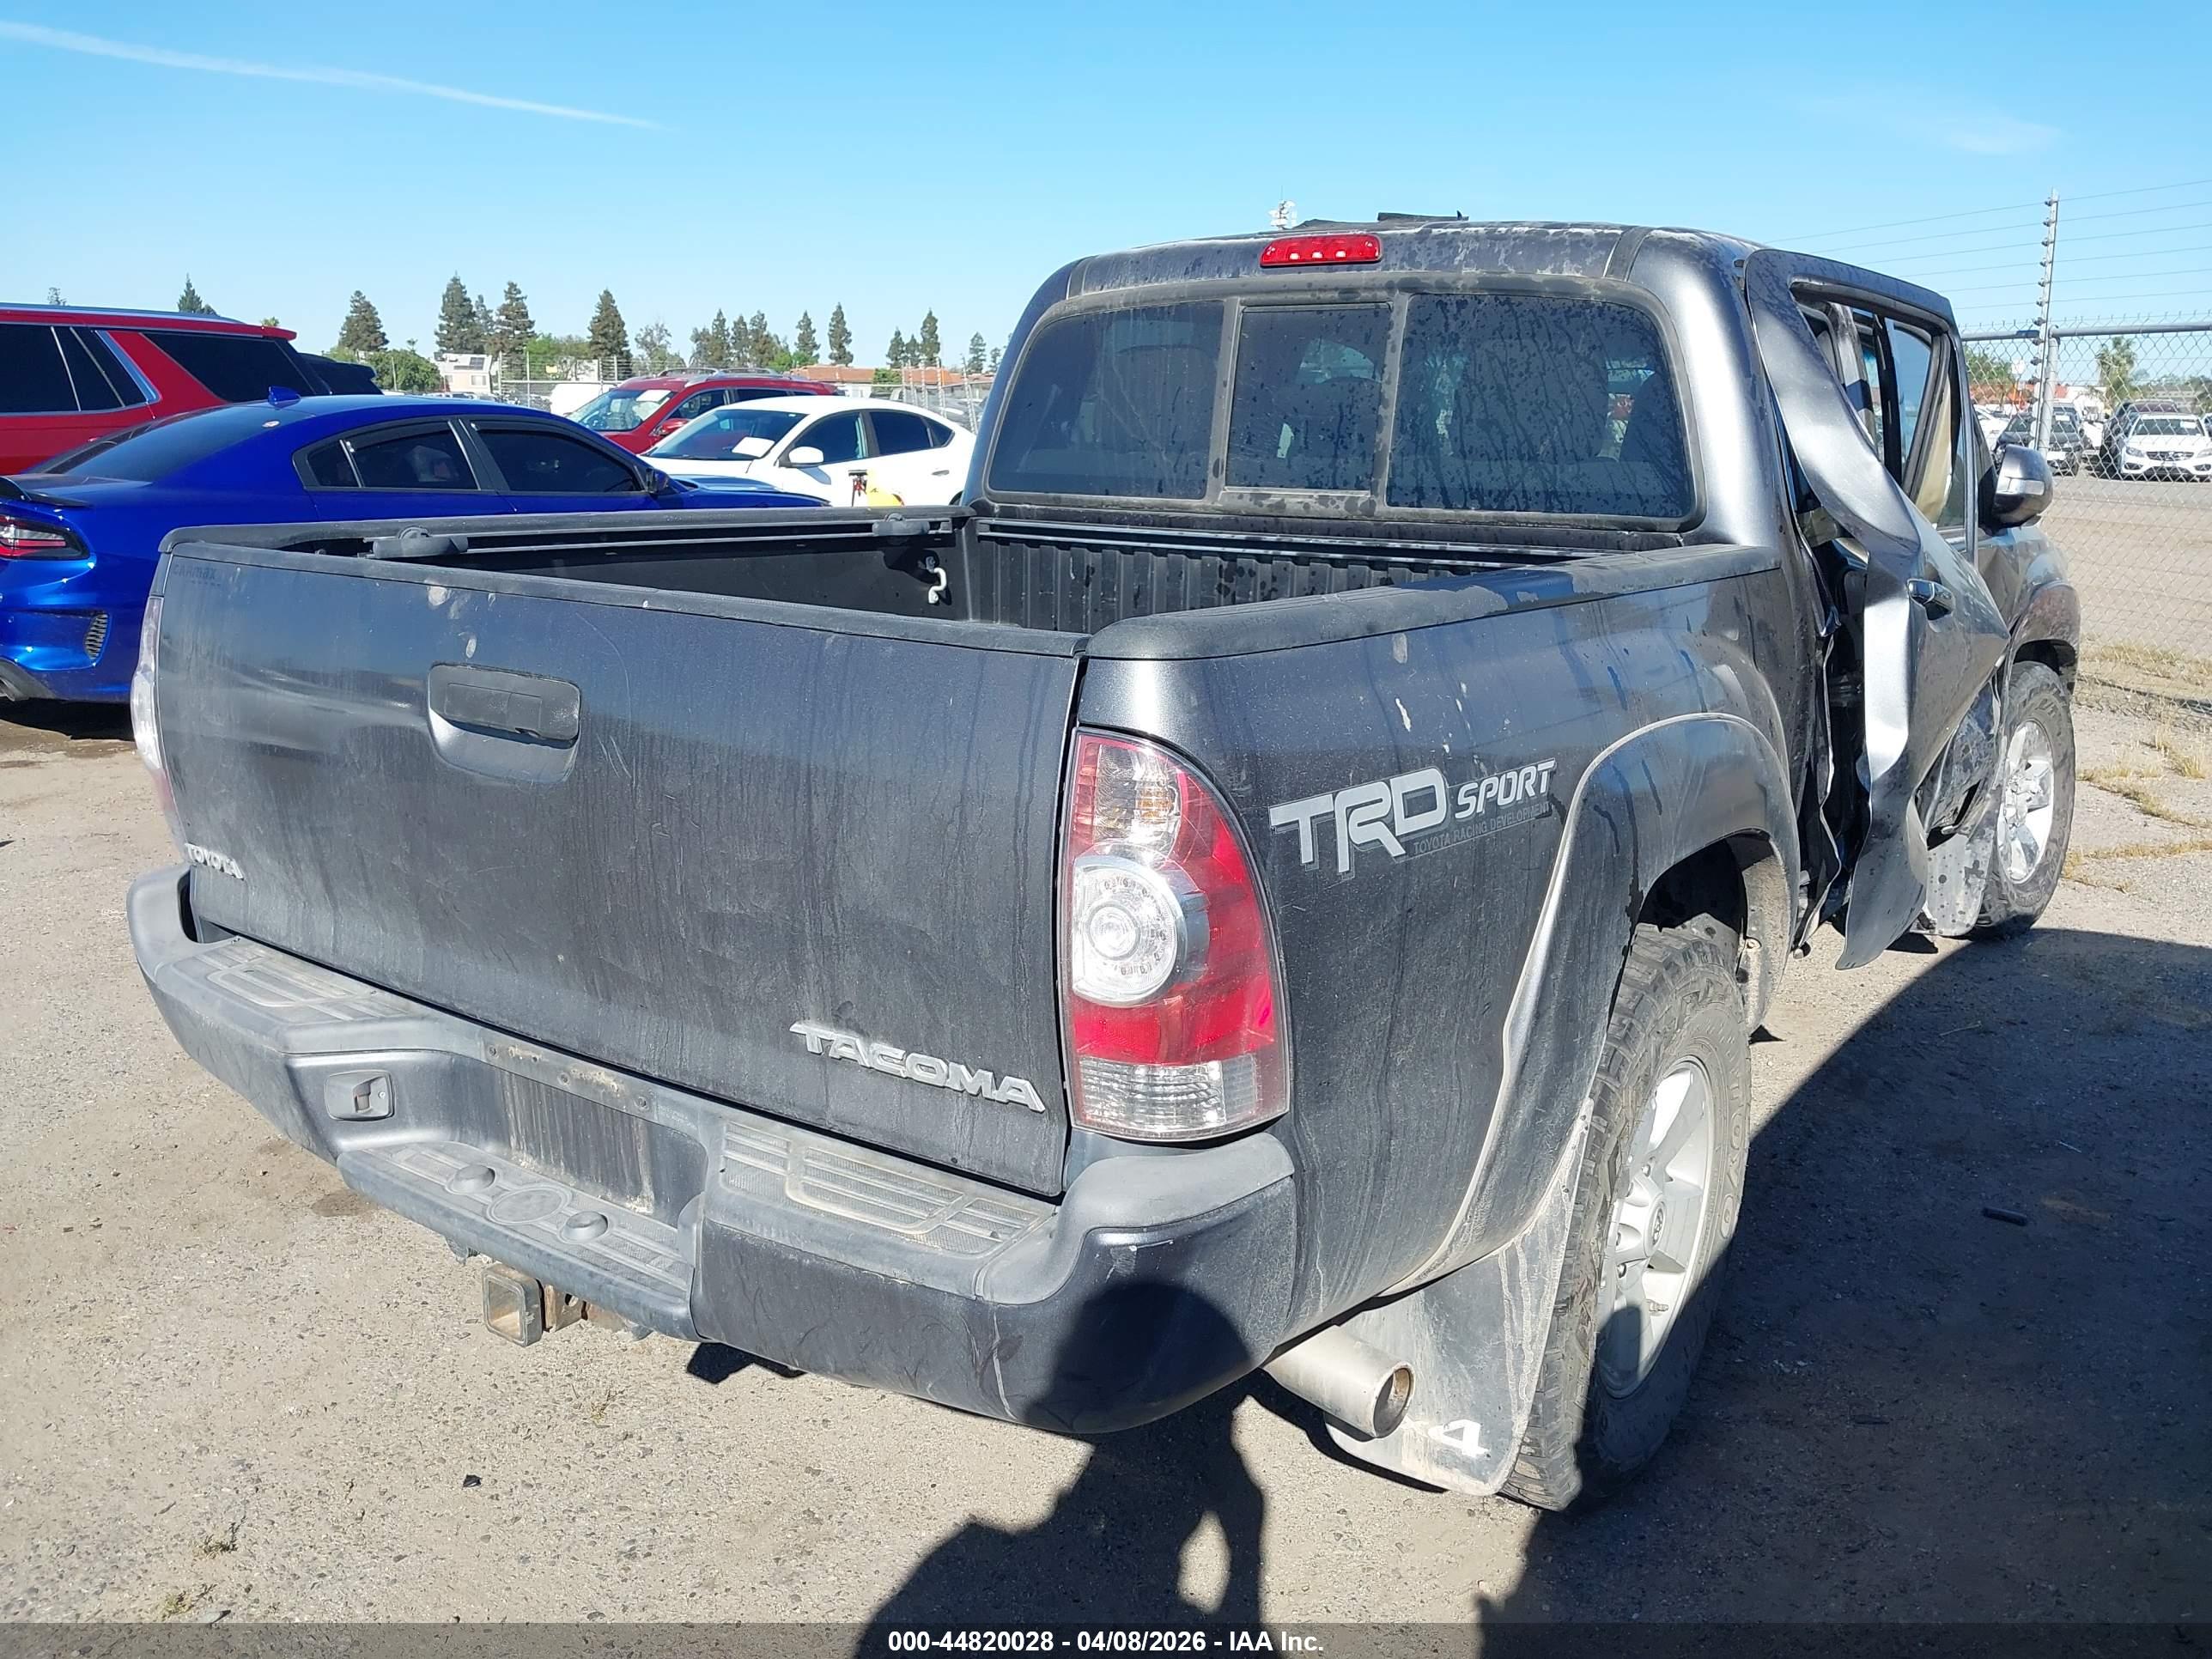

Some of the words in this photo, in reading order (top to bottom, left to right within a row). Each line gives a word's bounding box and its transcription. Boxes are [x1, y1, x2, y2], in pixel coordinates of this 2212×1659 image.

[1269, 768, 1448, 873] TRD
[1455, 758, 1556, 819] SPORT
[1413, 833, 1451, 854] TOYOTA
[1453, 821, 1488, 842] RACING
[789, 1020, 1046, 1114] TACOMA
